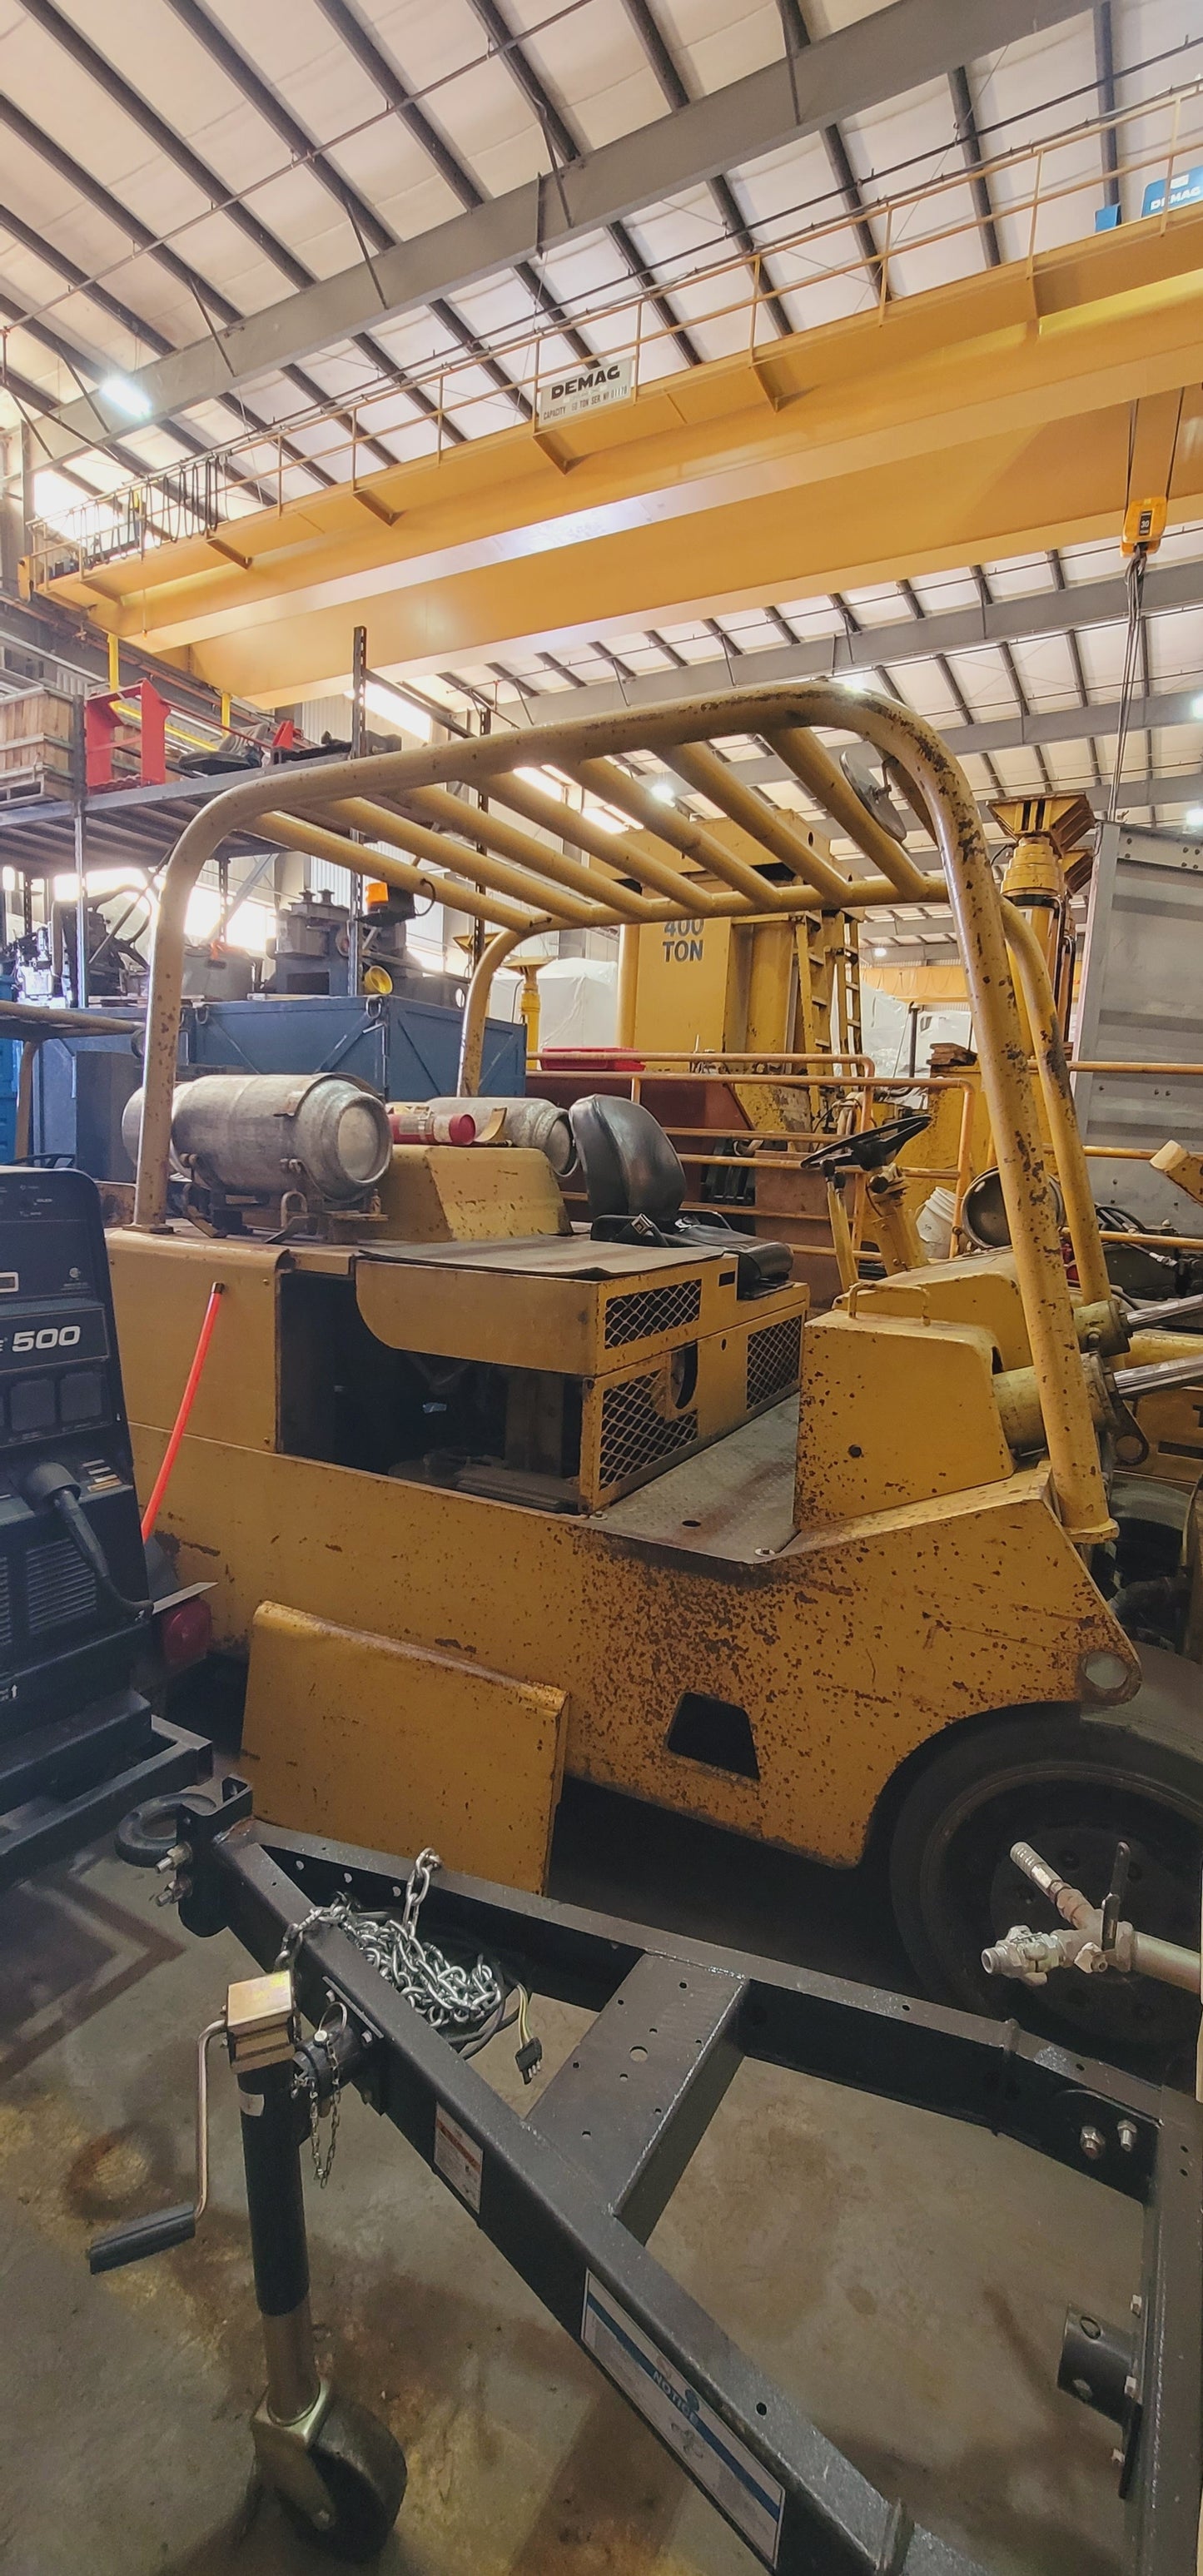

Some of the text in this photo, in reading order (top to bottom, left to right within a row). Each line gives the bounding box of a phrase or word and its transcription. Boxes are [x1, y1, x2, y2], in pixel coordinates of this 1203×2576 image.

[551, 365, 620, 400] DEMAG
[544, 406, 566, 420] CAPACITY
[579, 399, 589, 410] TON
[664, 918, 704, 937] 400
[663, 939, 703, 962] TON
[12, 1325, 81, 1352] 500
